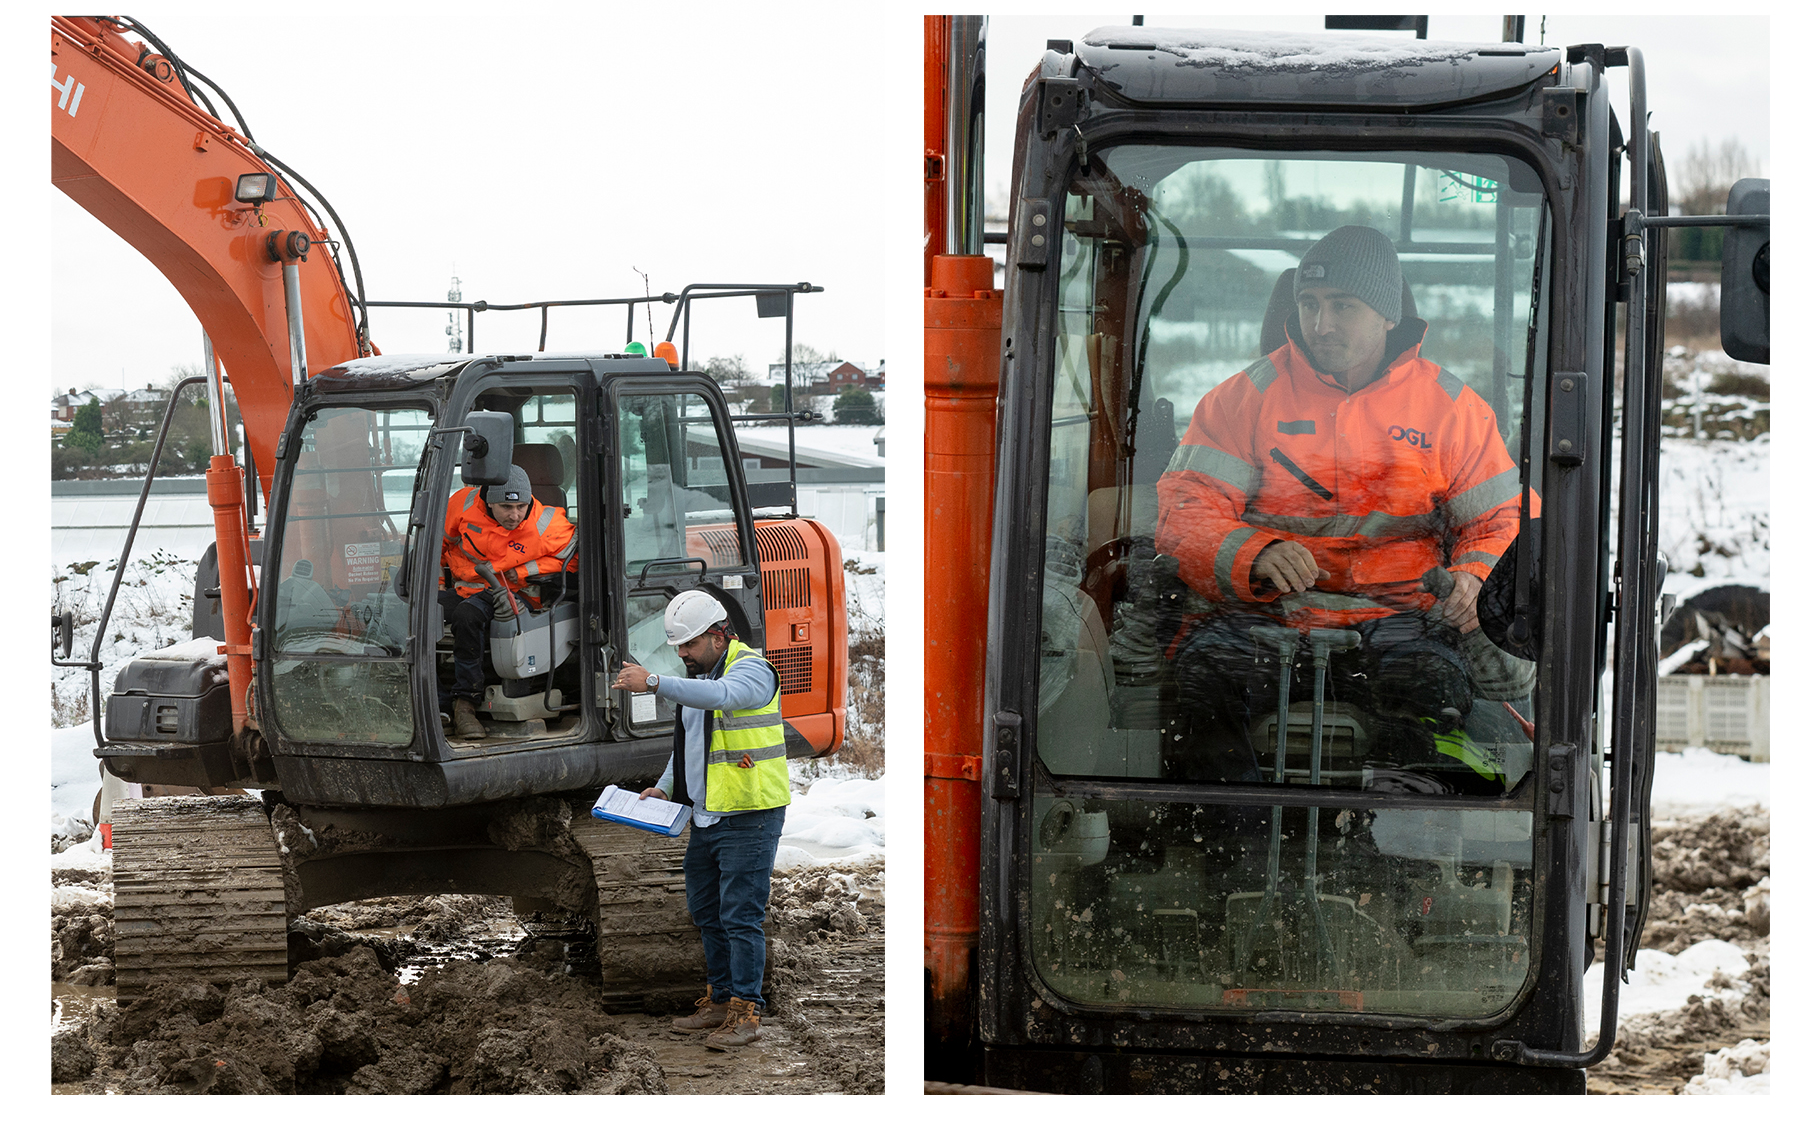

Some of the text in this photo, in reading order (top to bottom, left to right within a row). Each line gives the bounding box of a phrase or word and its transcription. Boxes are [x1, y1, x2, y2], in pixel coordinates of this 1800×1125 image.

[1387, 424, 1433, 449] OGL
[508, 540, 526, 554] OGL
[347, 556, 379, 565] WARNING
